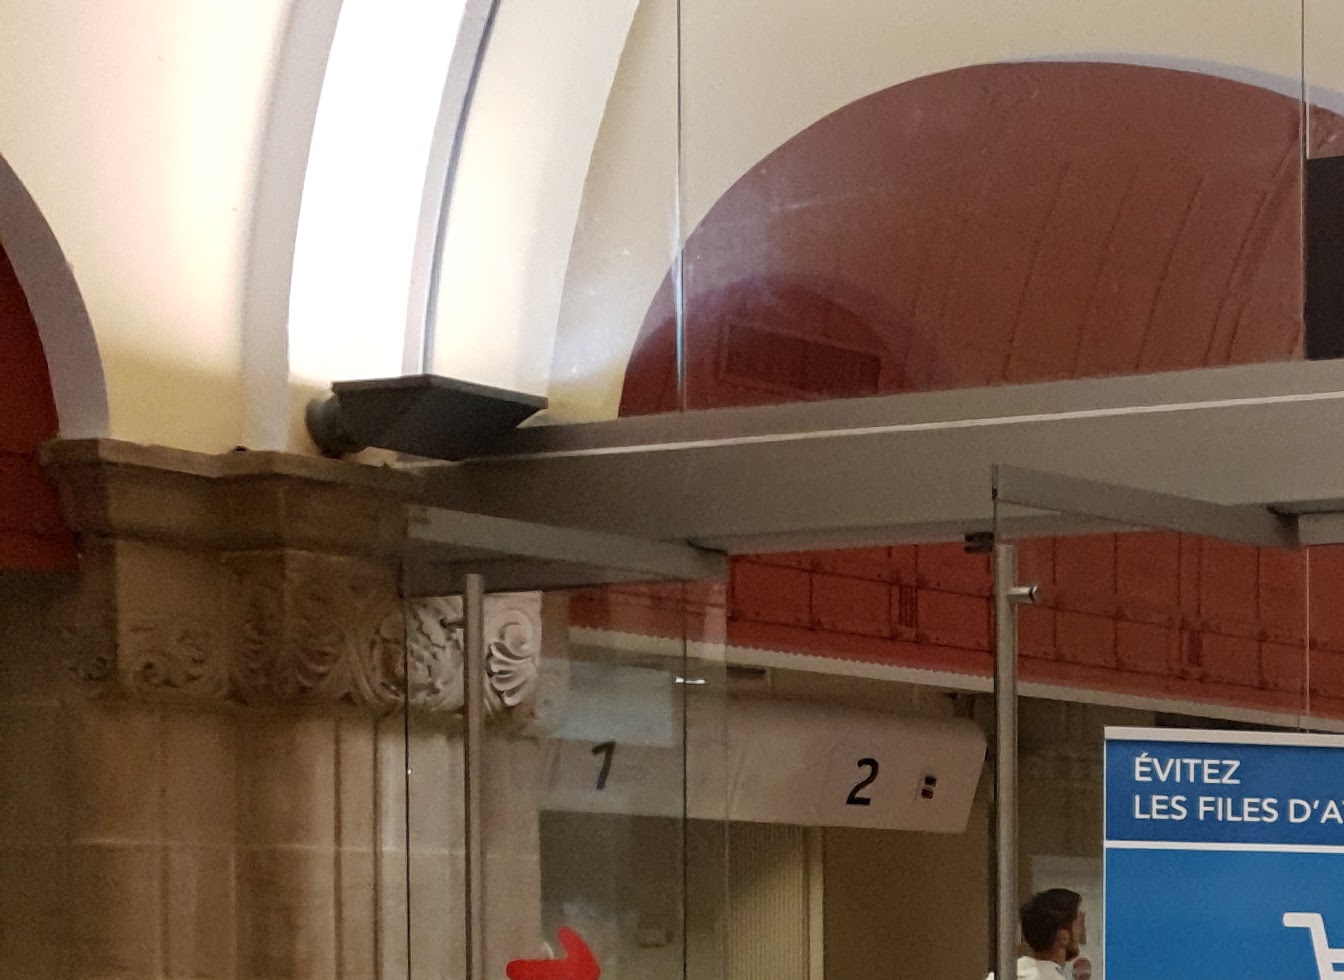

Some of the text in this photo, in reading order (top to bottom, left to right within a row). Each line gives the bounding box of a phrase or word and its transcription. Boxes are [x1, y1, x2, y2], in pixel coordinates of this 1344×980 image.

[591, 741, 615, 789] 1
[845, 758, 880, 806] 2
[1134, 753, 1241, 785] ÉVITEZ
[1134, 795, 1187, 820] LES
[1198, 796, 1279, 823] FILES
